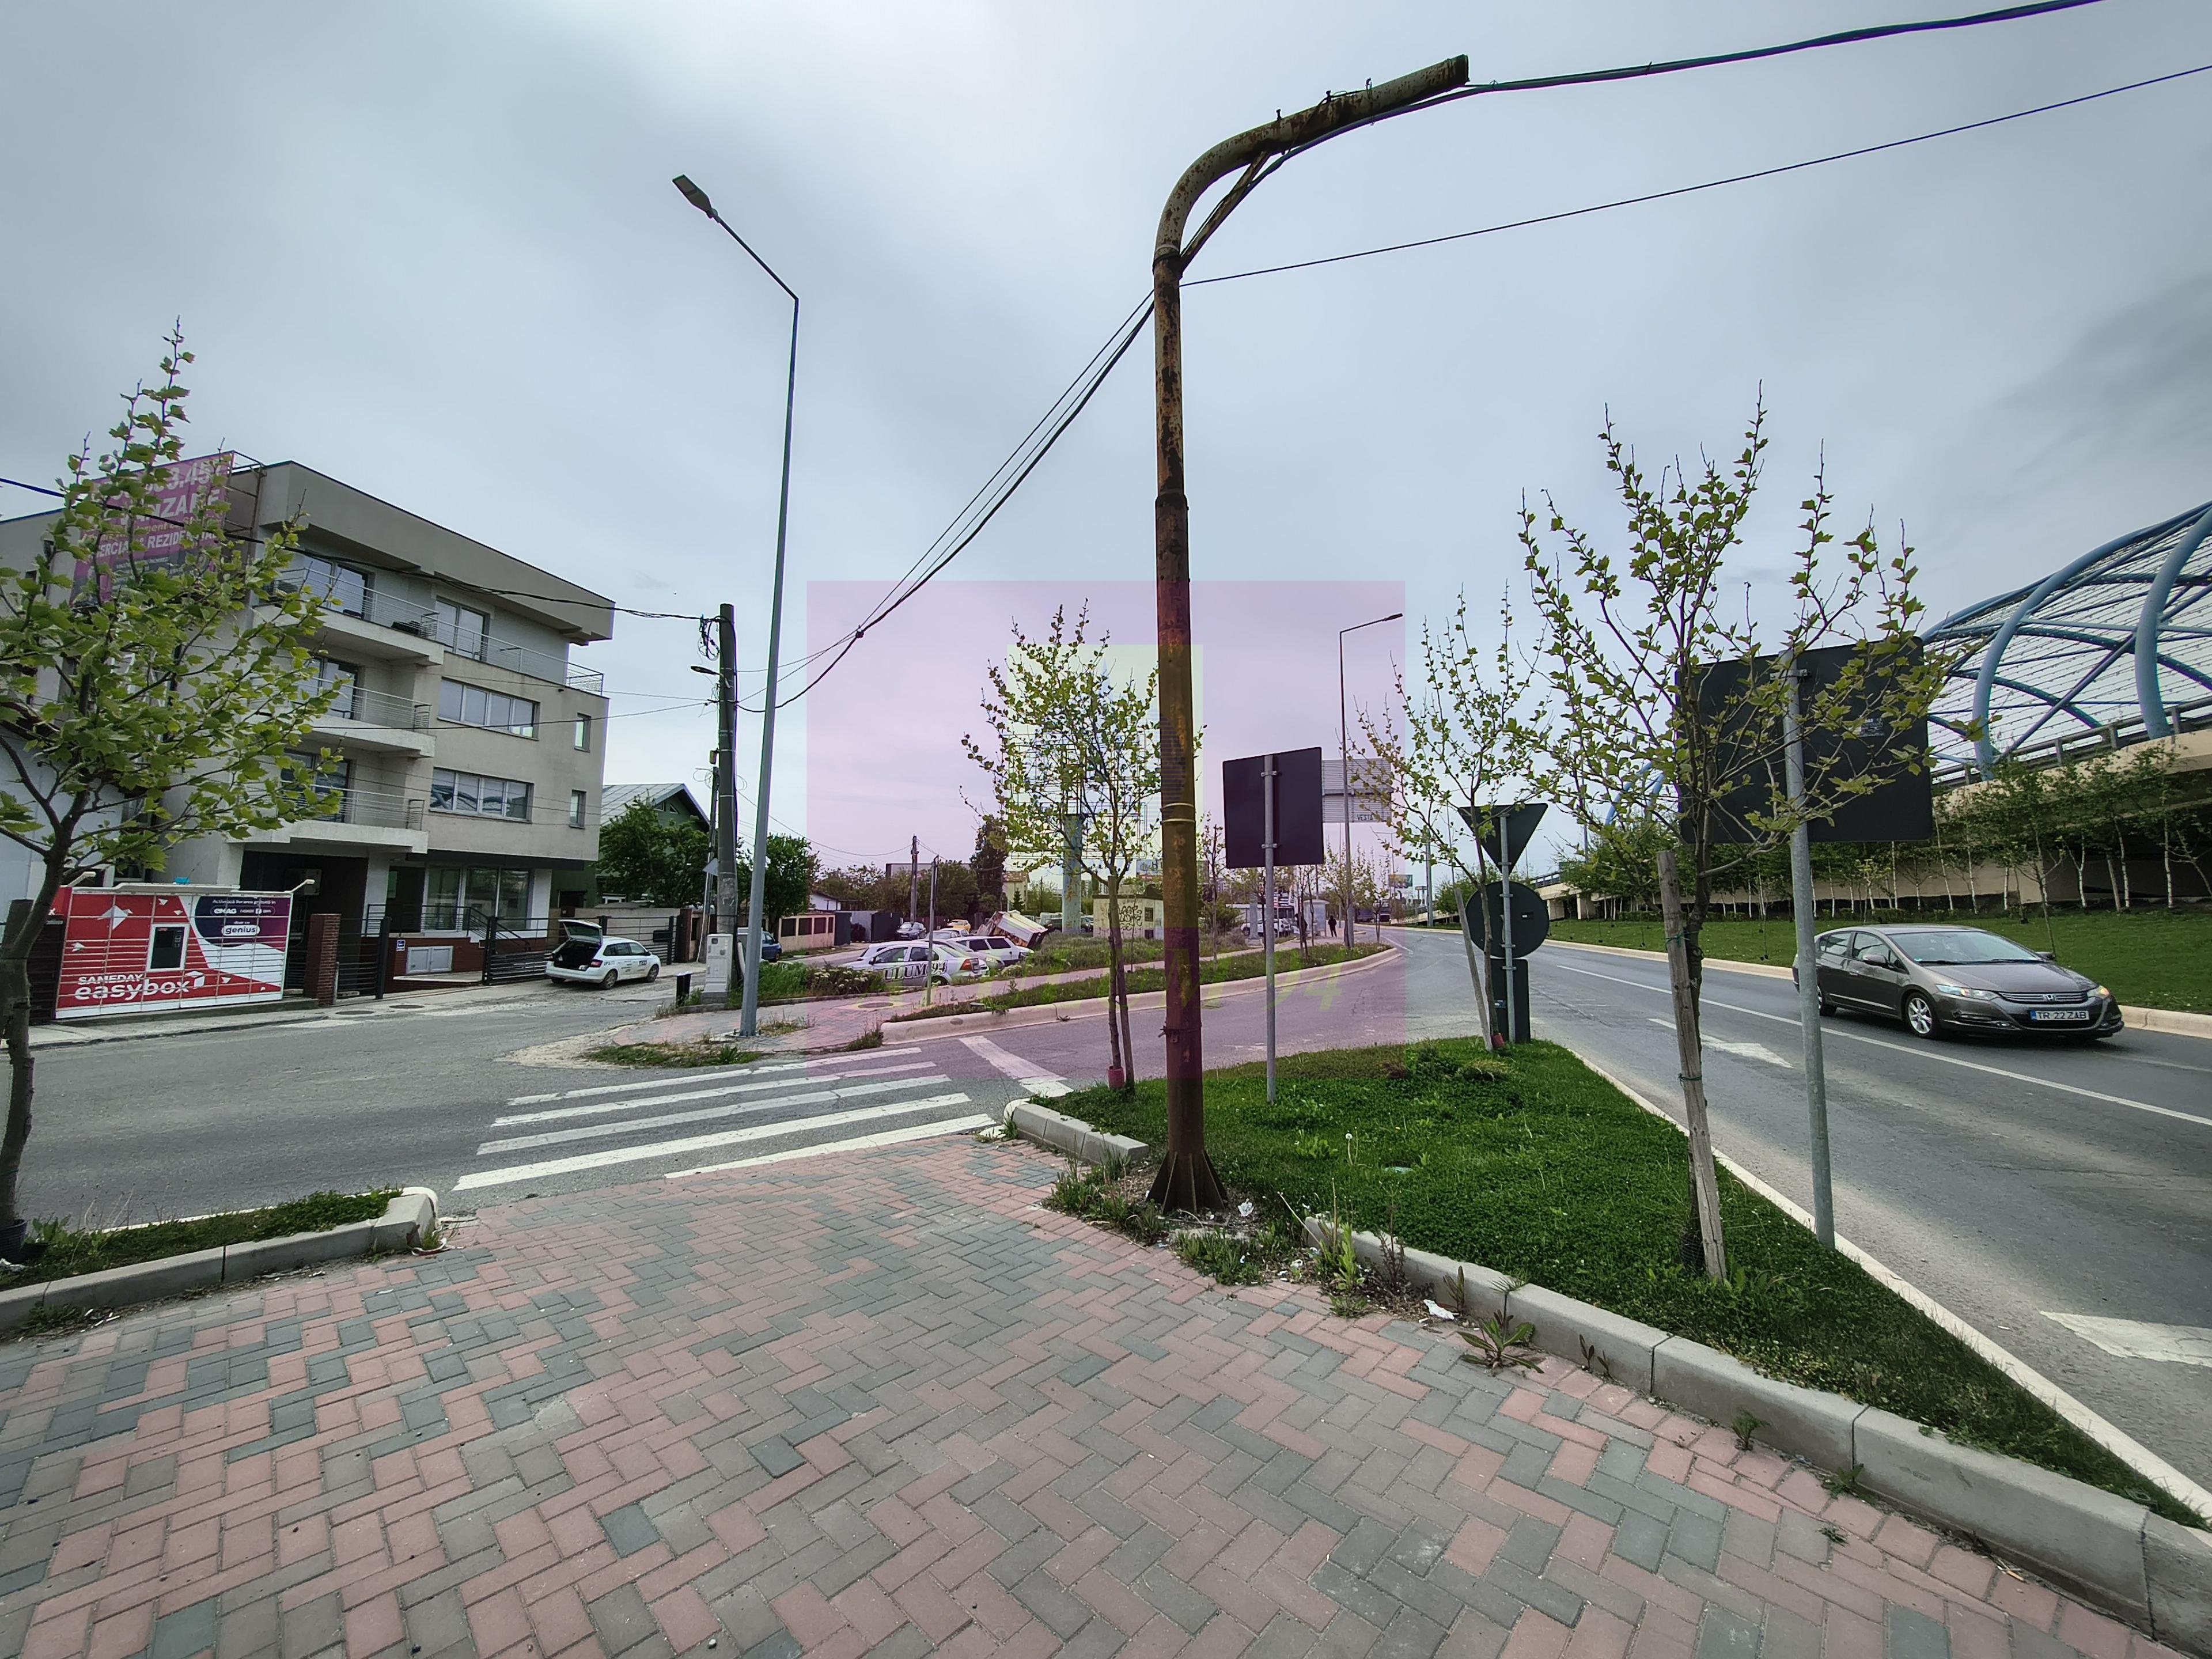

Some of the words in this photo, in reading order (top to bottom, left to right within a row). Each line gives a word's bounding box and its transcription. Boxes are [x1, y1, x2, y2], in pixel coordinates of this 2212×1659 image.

[119, 488, 221, 525] NZARE
[226, 926, 256, 935] genius
[77, 974, 143, 986] SAMEDAY
[884, 963, 928, 982] ULUM
[74, 979, 190, 1001] easybox
[2067, 1011, 2086, 1019] ZAB
